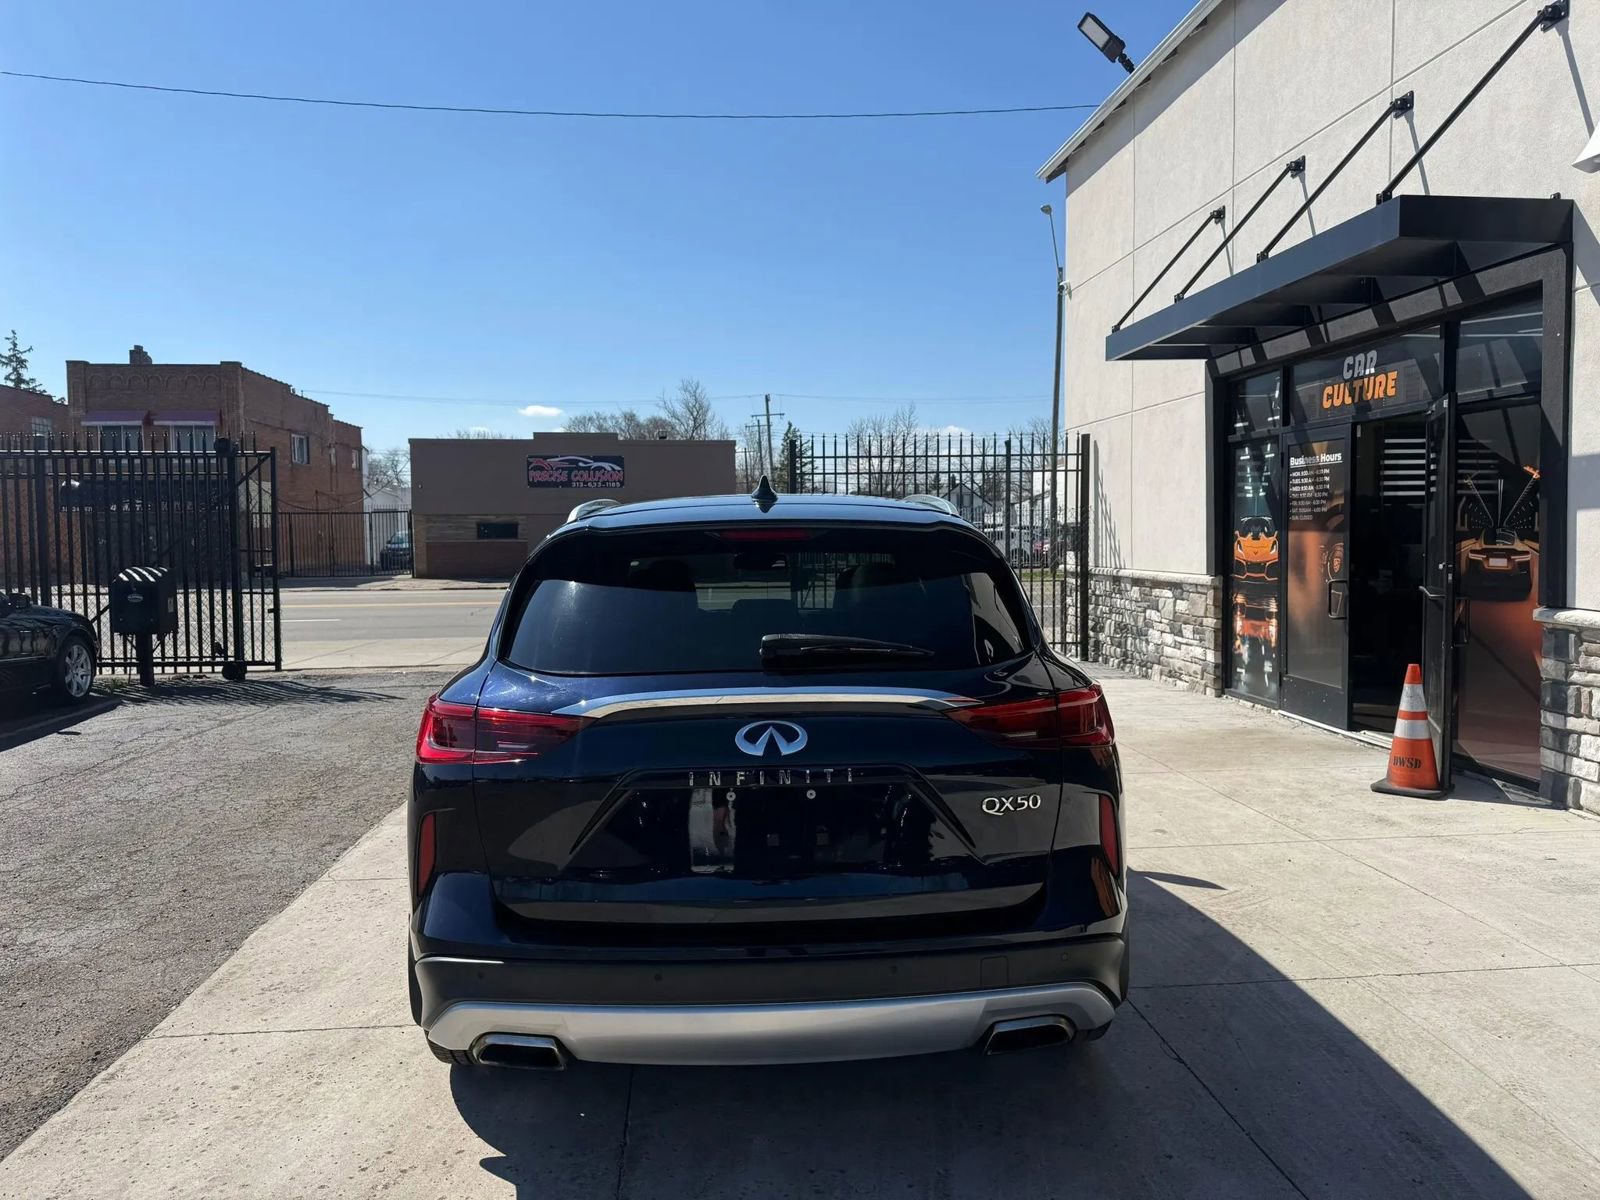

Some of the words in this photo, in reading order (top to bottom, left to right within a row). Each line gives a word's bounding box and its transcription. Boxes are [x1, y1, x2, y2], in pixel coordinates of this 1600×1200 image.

[1343, 350, 1377, 380] CAR
[1322, 370, 1398, 409] CULTURE
[1290, 455, 1319, 465] Business
[1320, 453, 1342, 463] Hours
[571, 470, 623, 482] COLLISION
[1393, 755, 1422, 769] DWSD
[688, 768, 853, 787] INFINITI
[981, 794, 1042, 816] QX50
